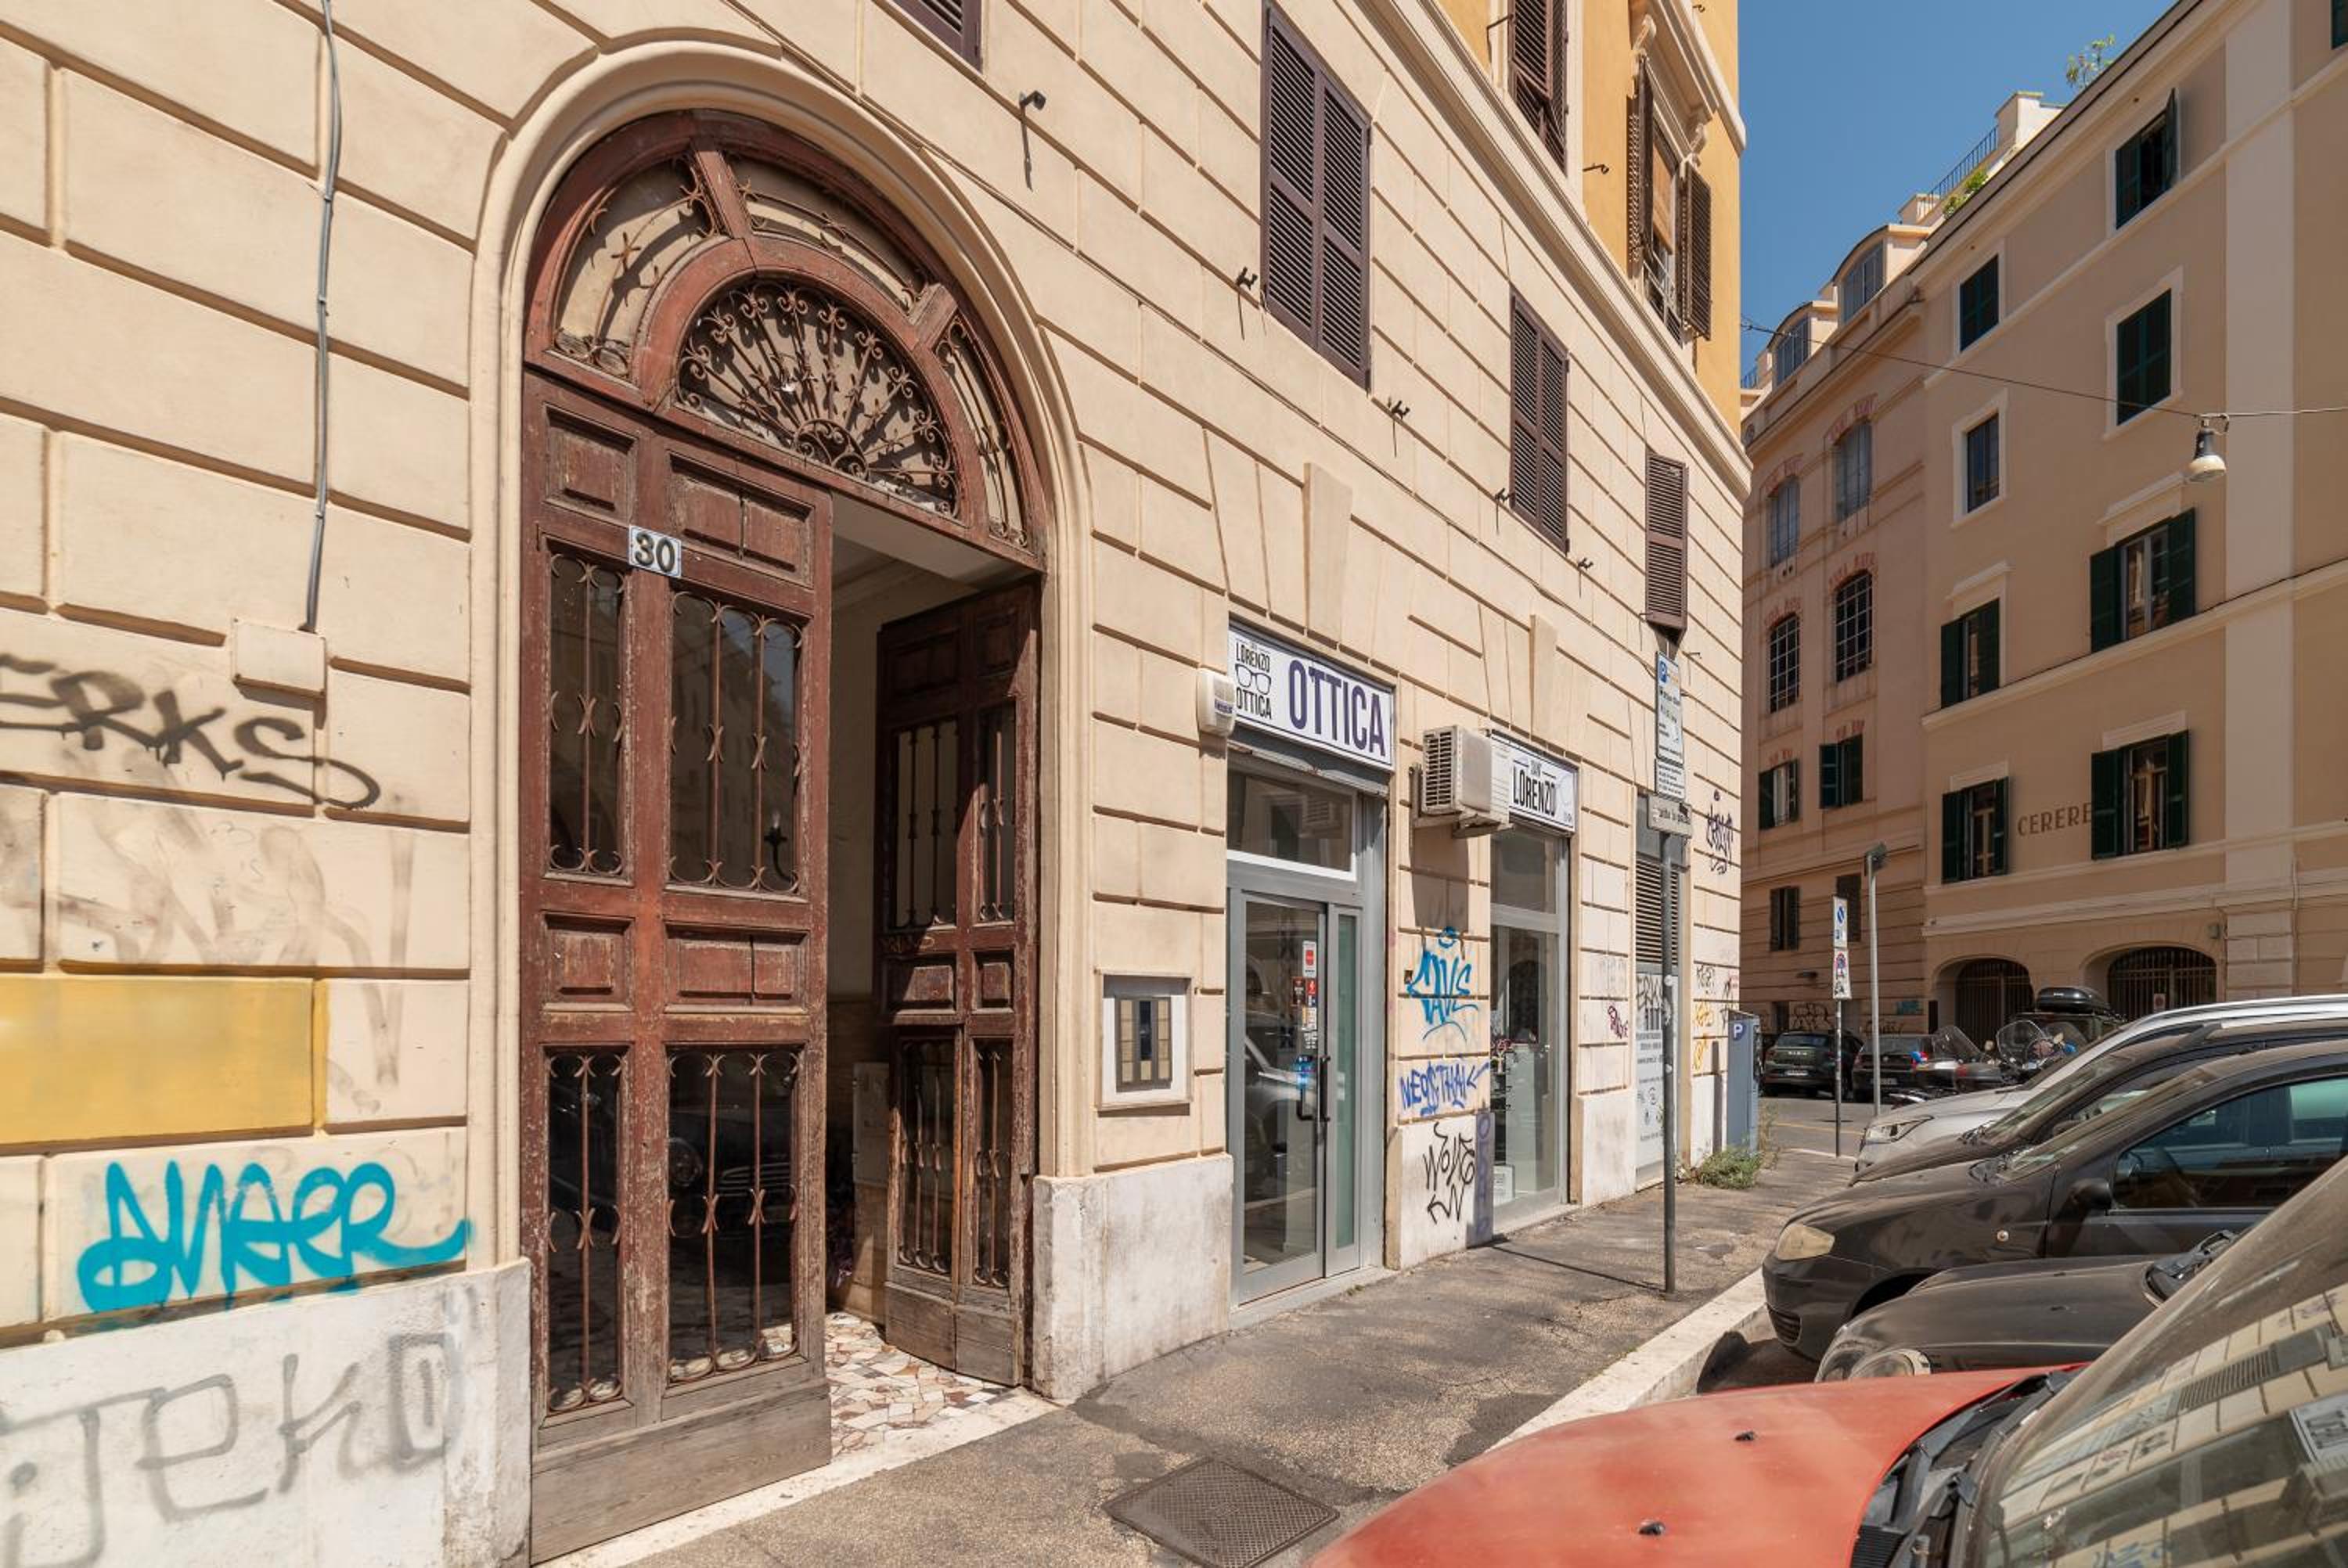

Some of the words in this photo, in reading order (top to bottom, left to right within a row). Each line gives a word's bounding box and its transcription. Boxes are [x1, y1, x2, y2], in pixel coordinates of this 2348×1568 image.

[635, 533, 675, 572] 30
[1236, 642, 1270, 673] LORENZO
[1236, 687, 1272, 720] OTTICA
[1288, 660, 1386, 757] OTTICA
[1513, 766, 1556, 817] LORENZO
[2018, 803, 2091, 836] CERERE
